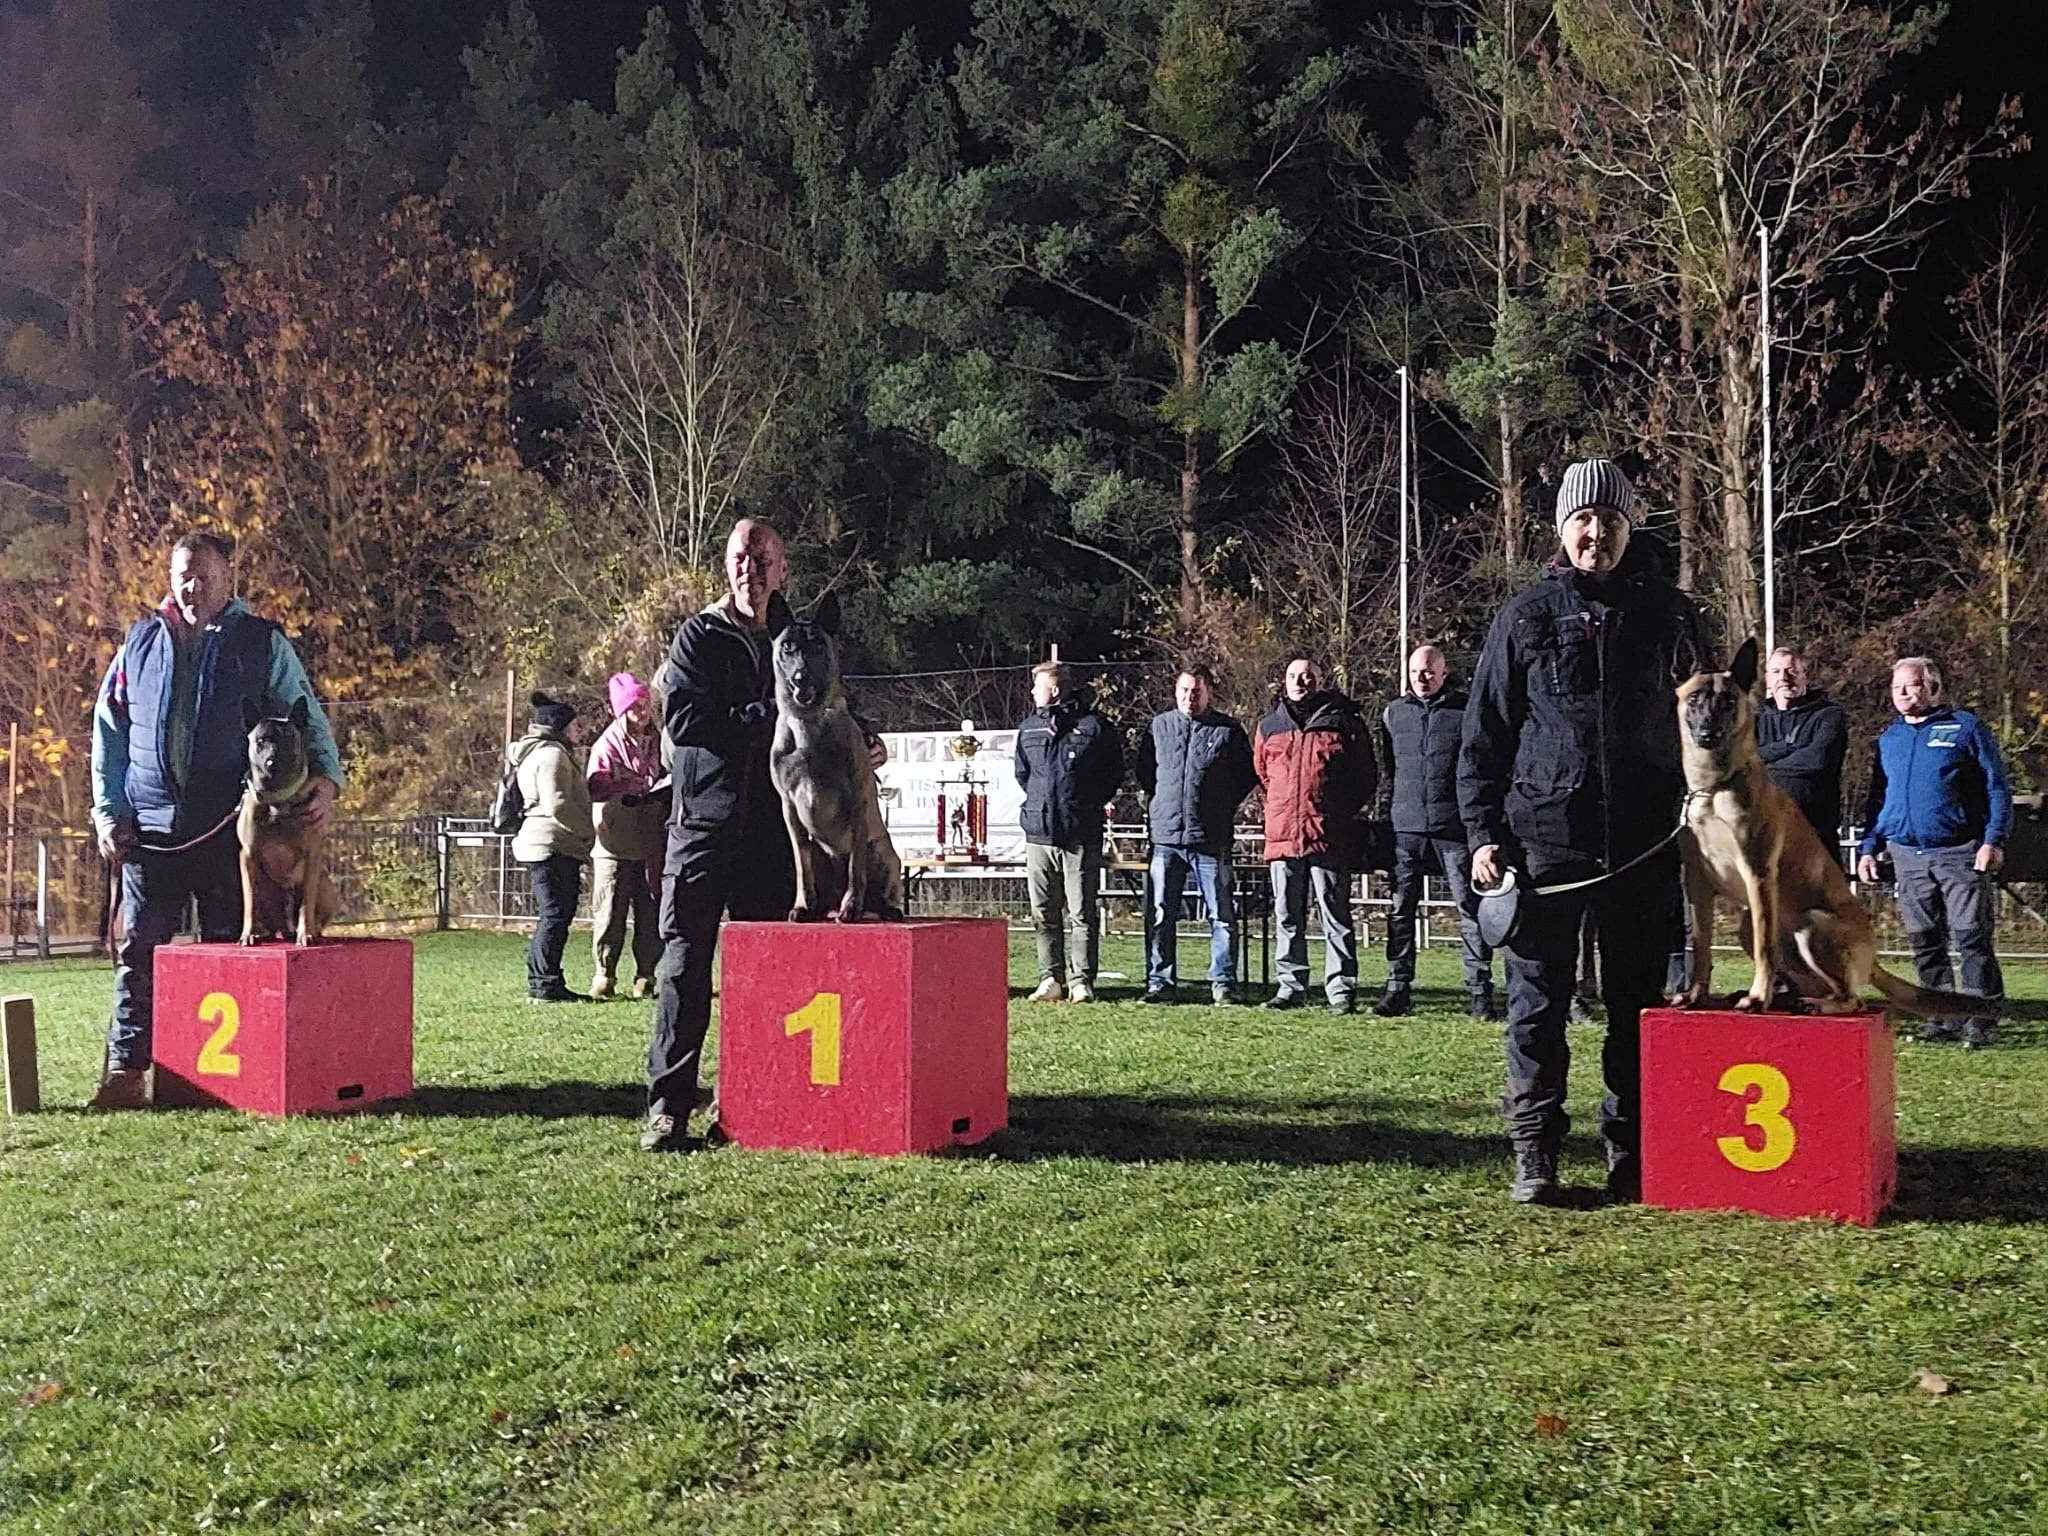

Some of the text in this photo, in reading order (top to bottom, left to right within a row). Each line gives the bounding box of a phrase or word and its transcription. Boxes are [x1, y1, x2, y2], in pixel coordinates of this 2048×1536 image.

[196, 991, 241, 1077] 2
[784, 992, 842, 1086] 1
[1717, 1063, 1796, 1171] 3
